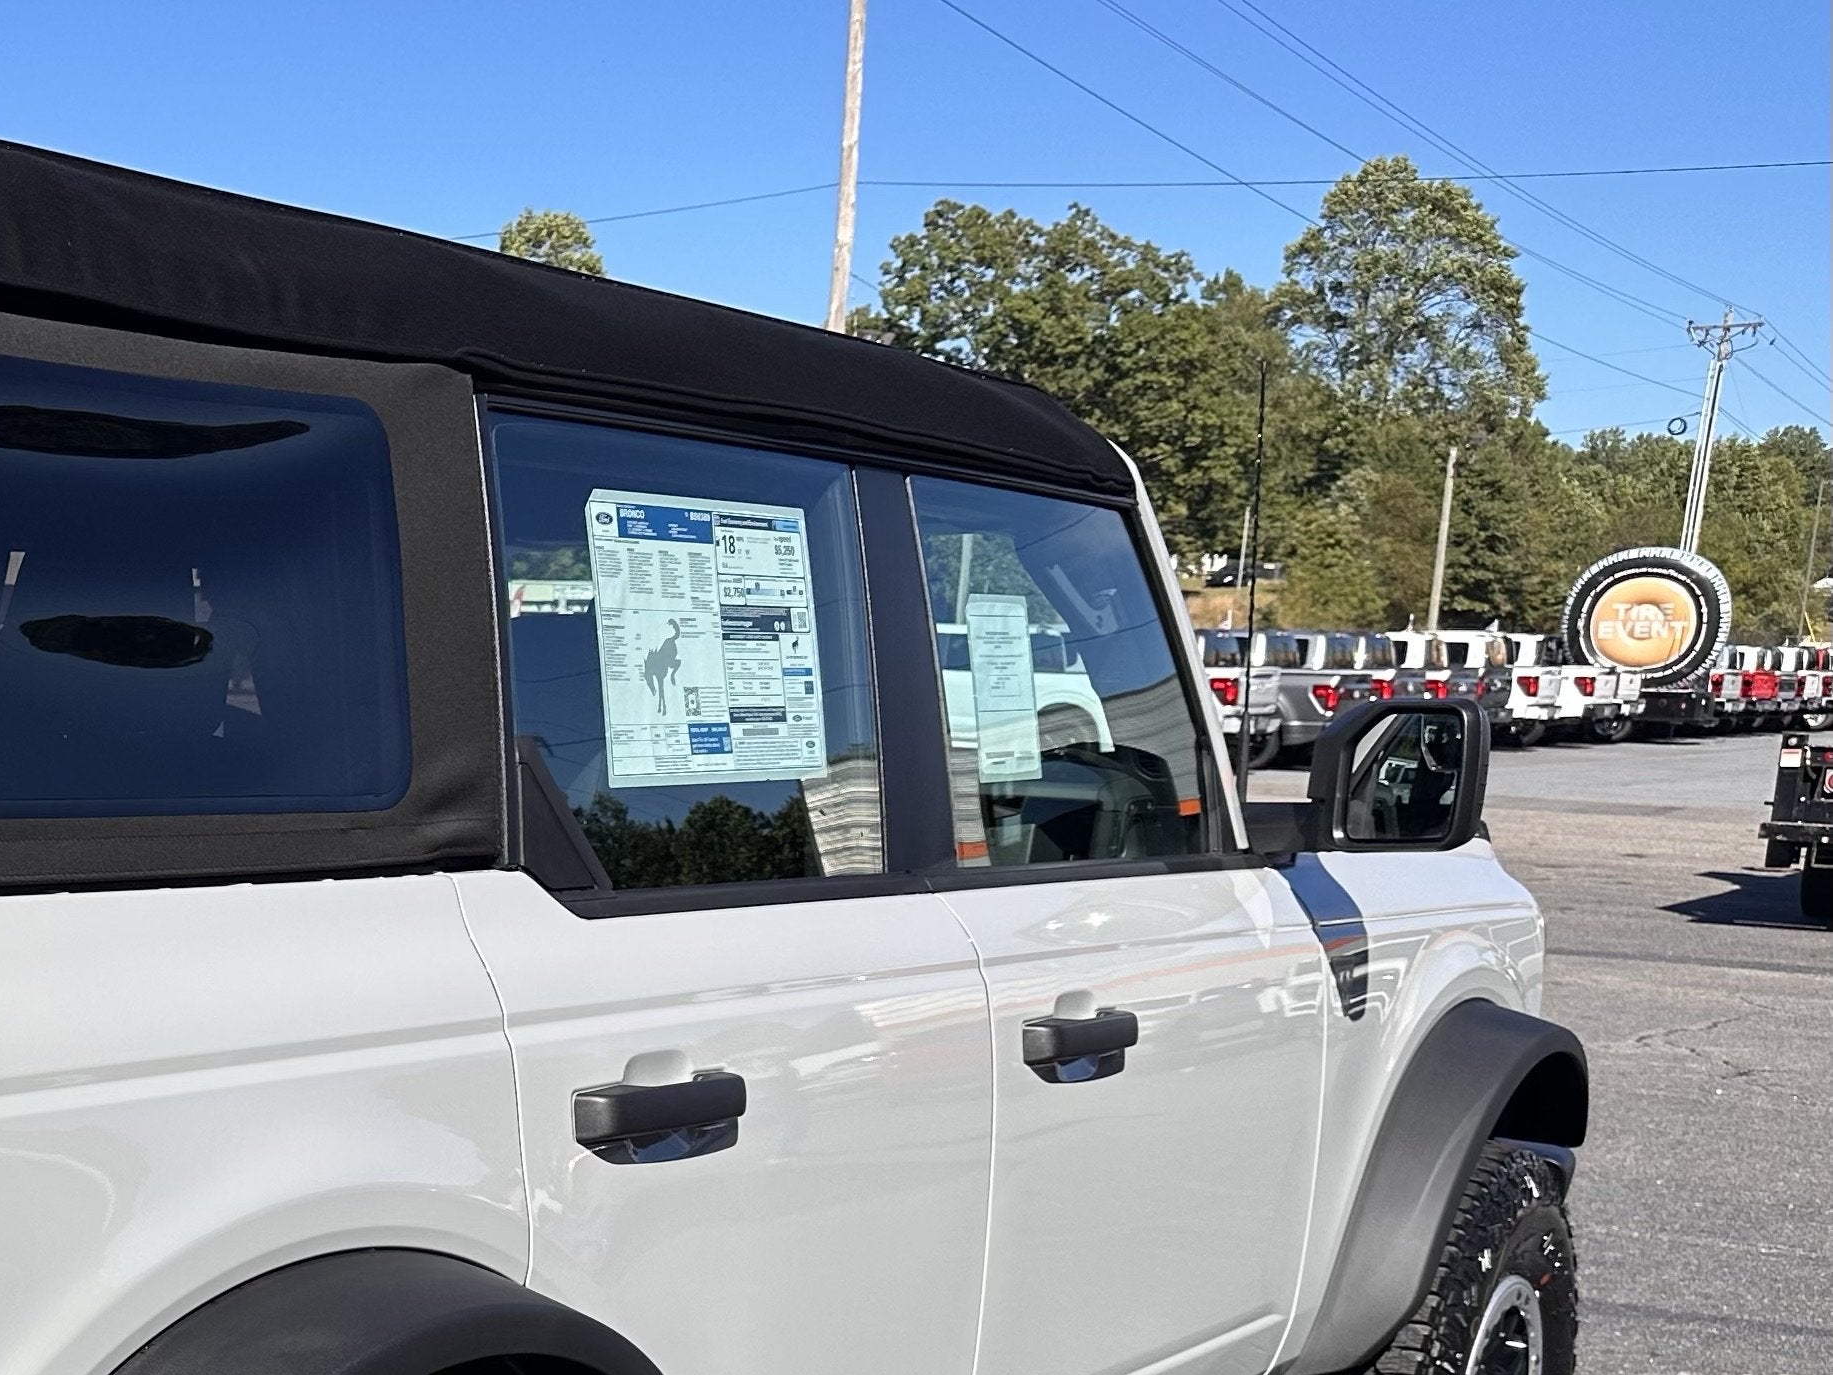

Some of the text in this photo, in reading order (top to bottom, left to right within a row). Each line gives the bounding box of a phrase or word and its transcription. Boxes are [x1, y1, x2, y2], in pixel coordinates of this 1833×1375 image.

[722, 535, 736, 555] 18
[1612, 602, 1675, 621] TIRE
[1598, 620, 1688, 640] EVENT
